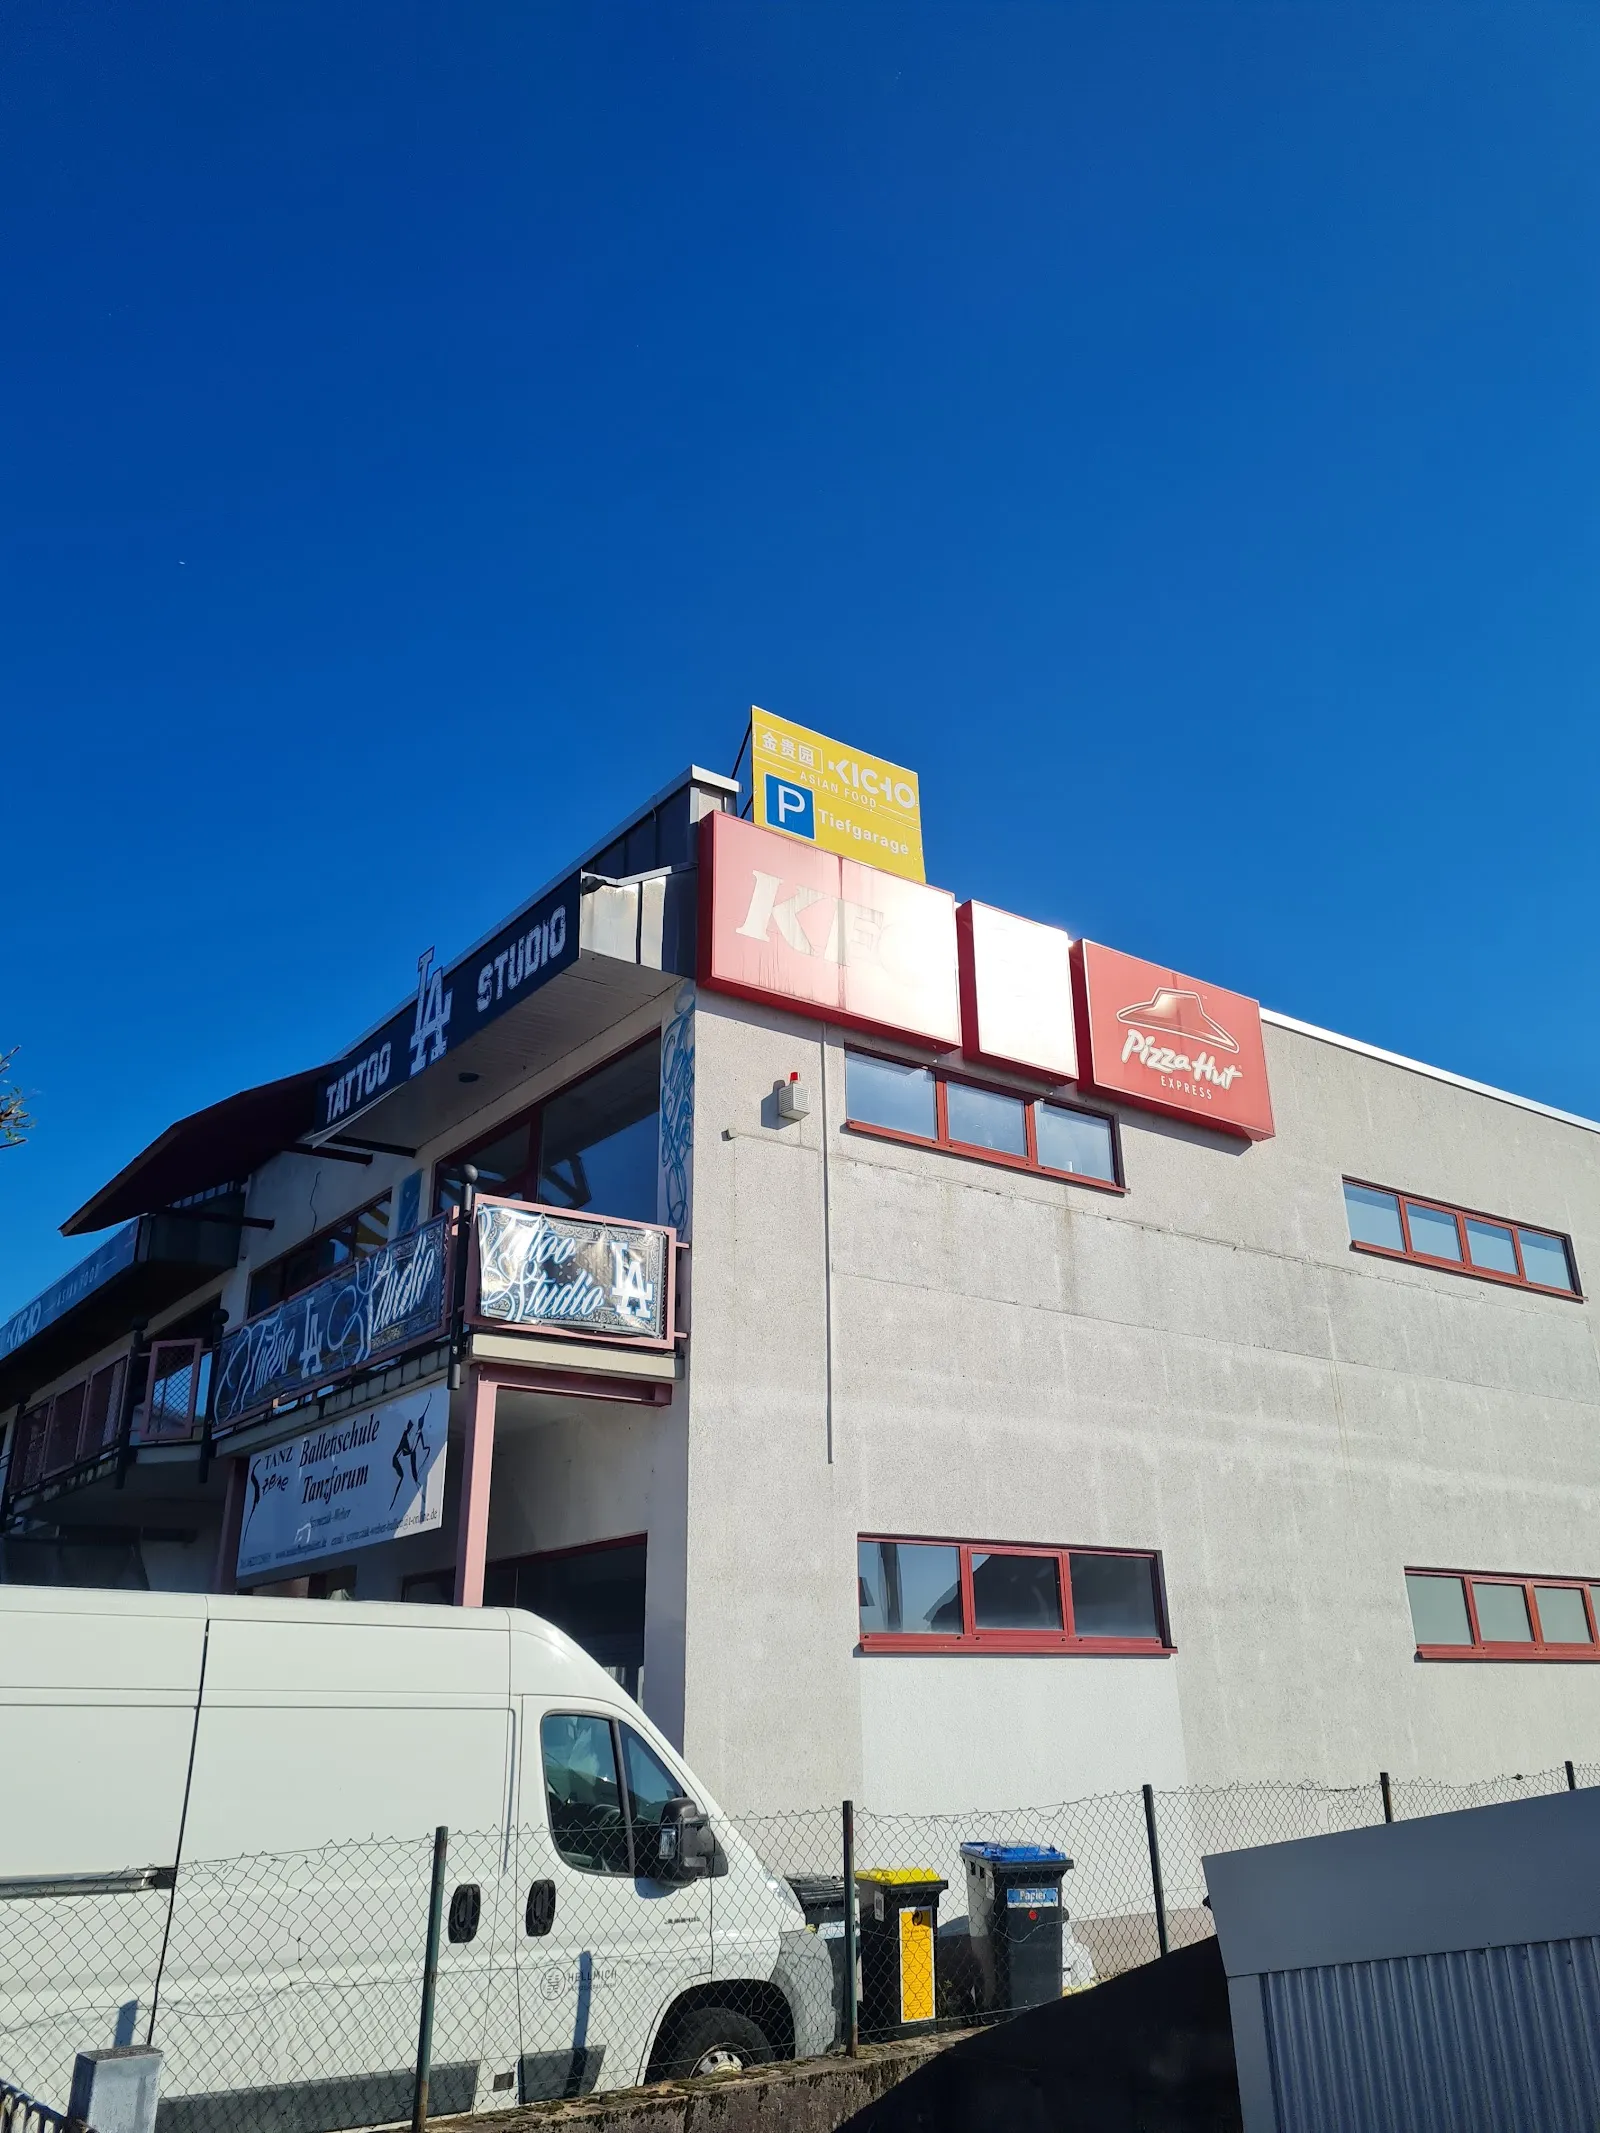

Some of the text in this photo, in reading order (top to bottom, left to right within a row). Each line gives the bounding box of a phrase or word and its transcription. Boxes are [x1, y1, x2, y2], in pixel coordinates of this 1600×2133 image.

[778, 784, 806, 824] P
[800, 770, 877, 809] ASIAN FOOD
[818, 807, 910, 855] Tiefgarage
[326, 904, 567, 1124] TATTOO LA STUDIO
[1120, 1028, 1244, 1090] Pizza Hut
[1160, 1075, 1213, 1100] EXPRESS
[265, 1446, 294, 1470] TANZ
[299, 1412, 380, 1468] Ballettschule
[302, 1463, 370, 1505] Tanzforum
